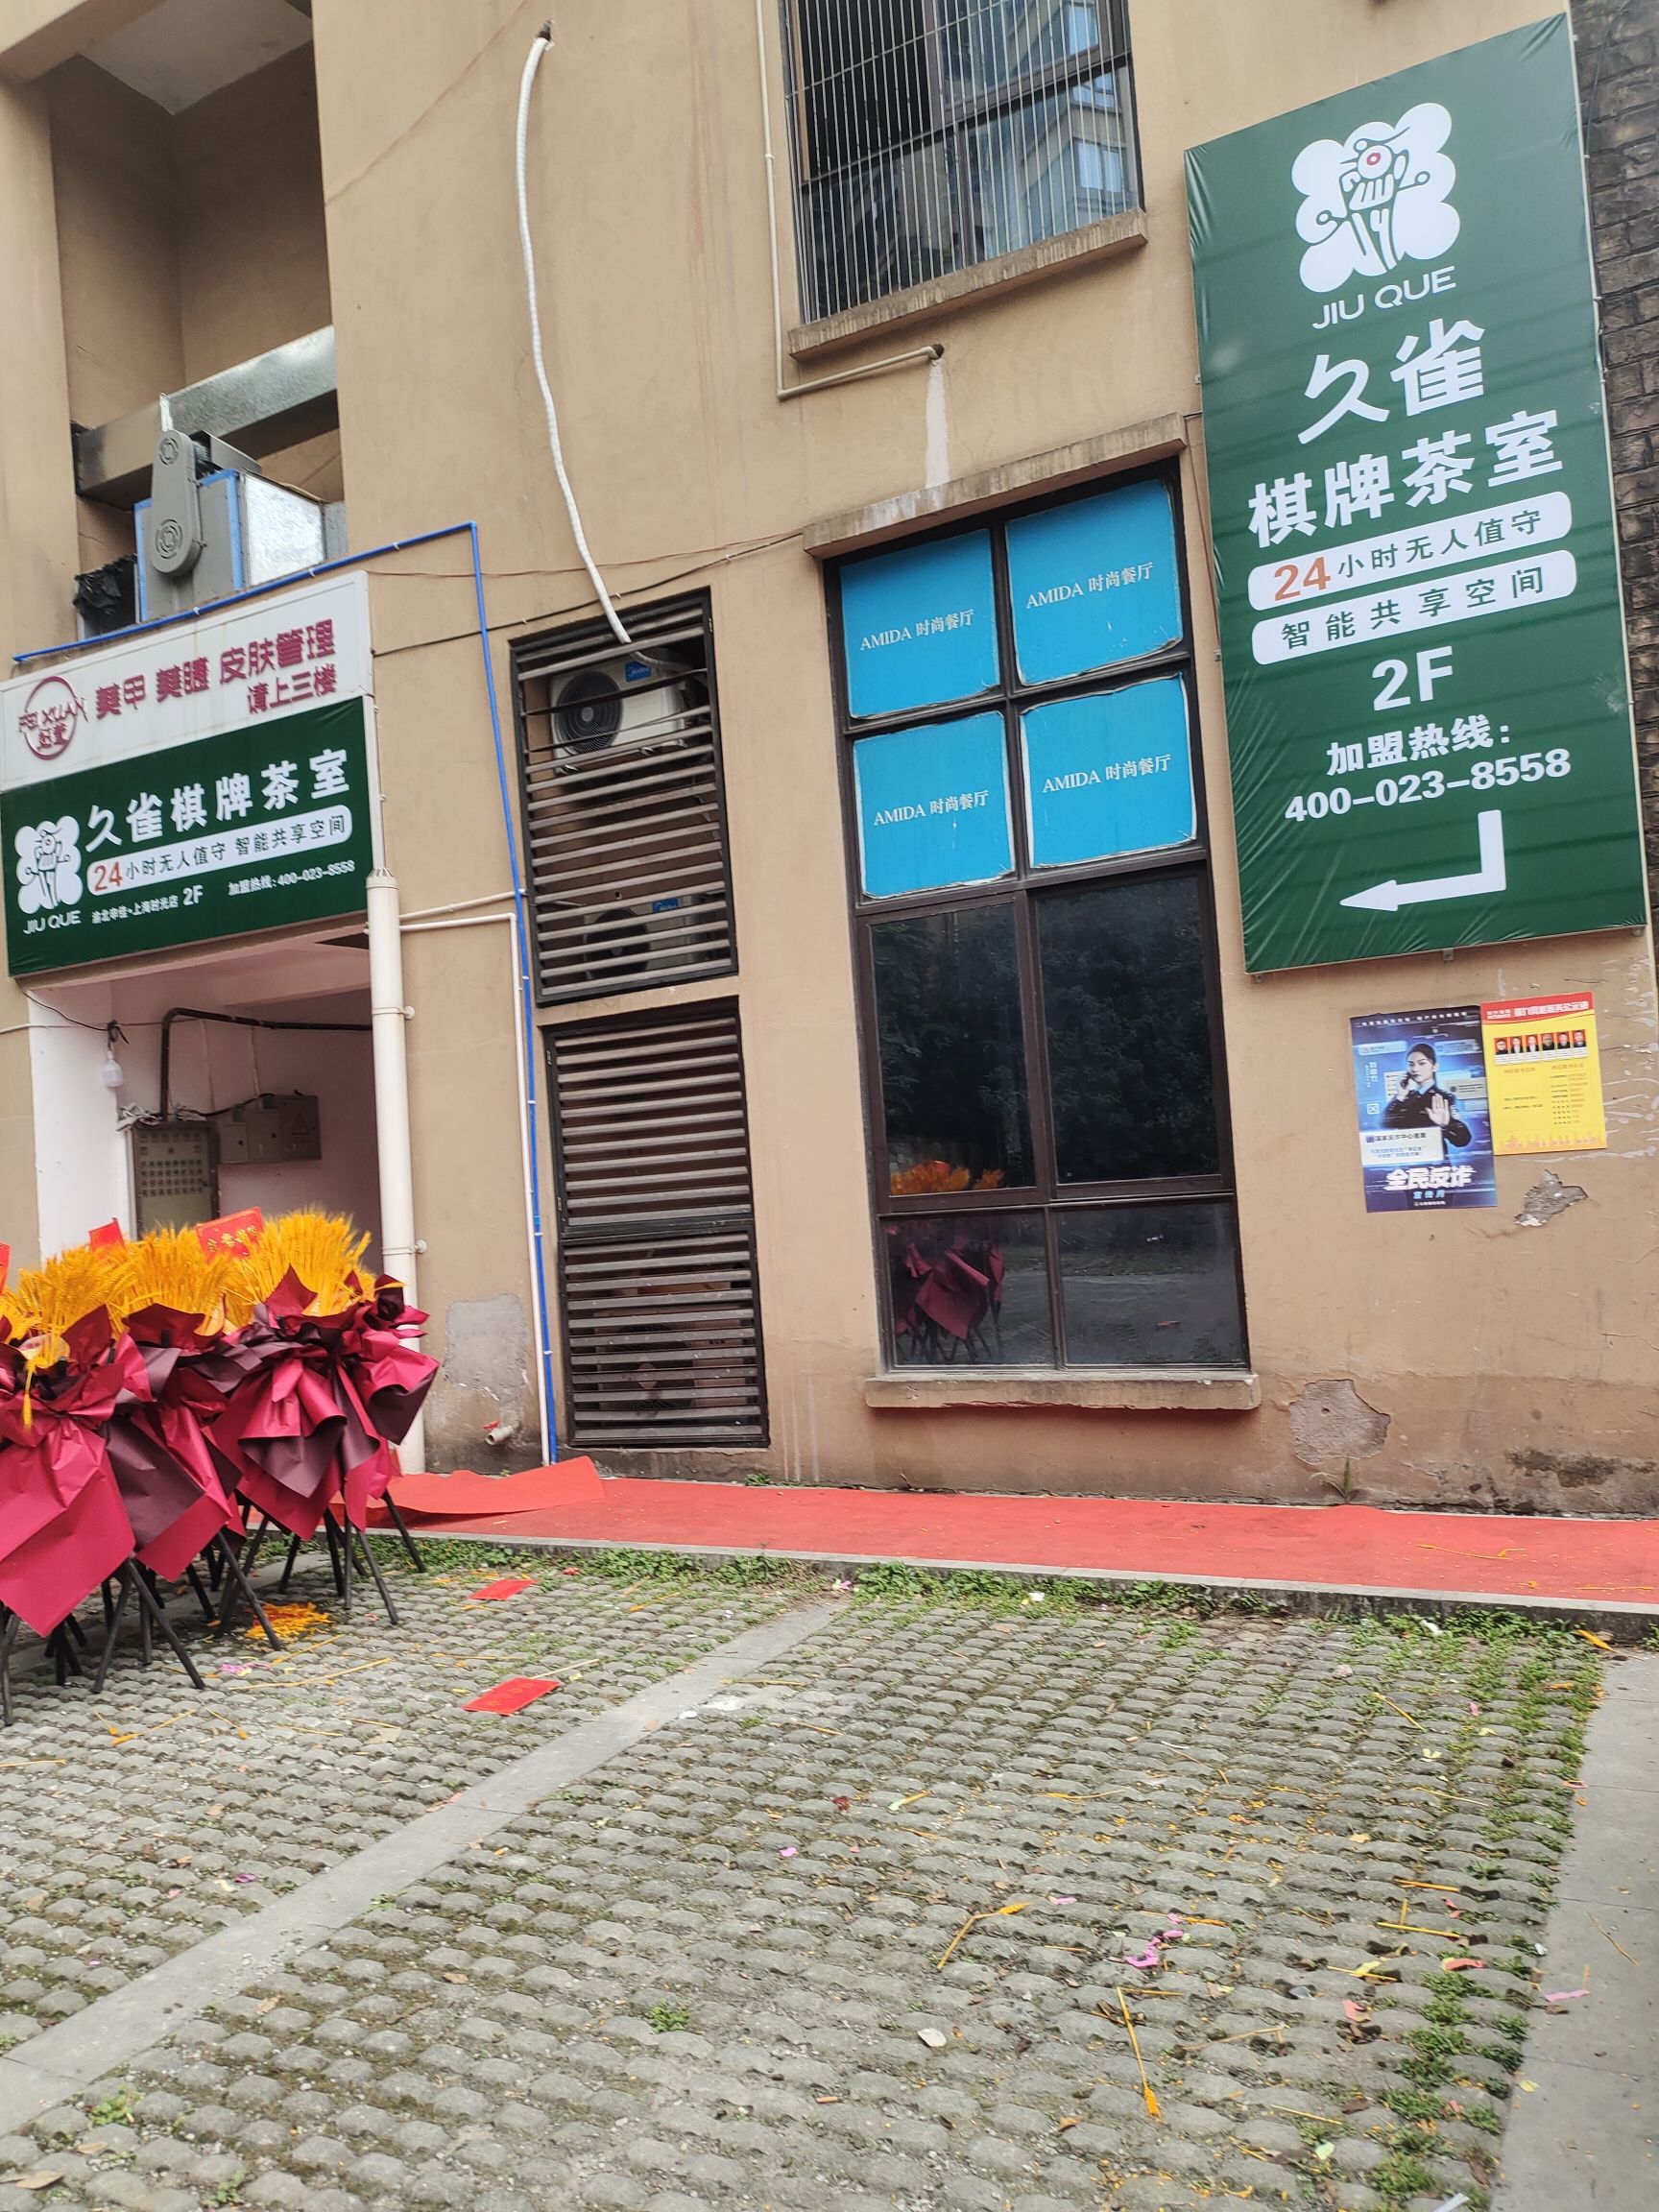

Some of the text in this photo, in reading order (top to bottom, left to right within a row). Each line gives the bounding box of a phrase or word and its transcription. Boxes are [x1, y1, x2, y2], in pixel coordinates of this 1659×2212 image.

[1311, 265, 1457, 329] JIU QUE
[1297, 318, 1486, 445] 久雀
[1248, 409, 1563, 548] 棋牌茶室
[1025, 562, 1154, 609] AMIDA 时尚餐厅
[1272, 509, 1542, 602] 24小时无人值守
[859, 609, 975, 651] AMIDA 时尚餐厅
[1281, 566, 1544, 650] 智能共享空间
[95, 674, 147, 720] 美甲
[219, 618, 336, 685] 皮肤管理
[1371, 645, 1454, 711] 2F
[84, 748, 350, 853] 久雀棋牌茶室
[1042, 754, 1172, 793] AMIDA 时尚餐厅
[1285, 748, 1572, 823] 400-023-8558
[873, 789, 990, 826] AMIDA 时尚餐厅
[93, 814, 347, 893] 24小时无人值守 智能共享空间
[22, 910, 82, 935] JIU QUE
[182, 884, 204, 906] 2F
[1382, 1165, 1478, 1191] 全民反诈
